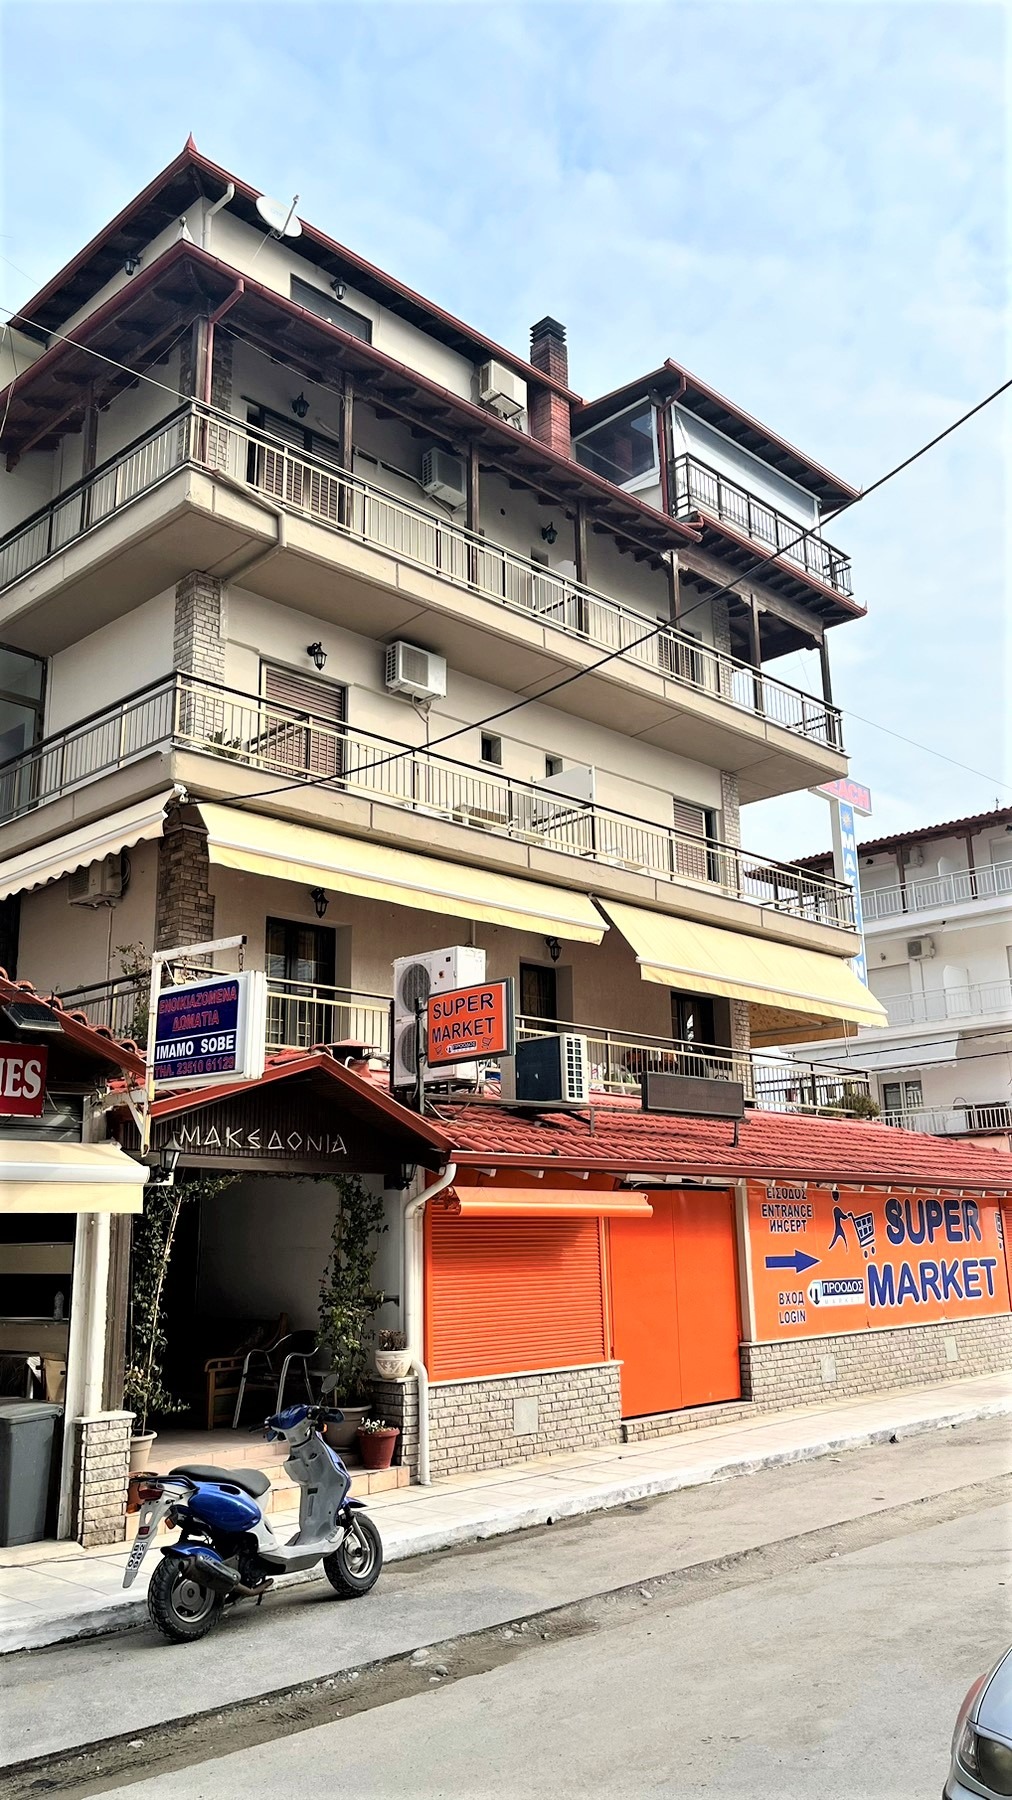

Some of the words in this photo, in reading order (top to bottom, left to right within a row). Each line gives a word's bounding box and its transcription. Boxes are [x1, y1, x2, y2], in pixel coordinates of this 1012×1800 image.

[433, 993, 494, 1019] SUPER
[172, 1009, 219, 1031] ΔΩΜΑΤΙΑ
[432, 1017, 496, 1043] MARKET
[156, 1041, 194, 1060] IMAMO
[201, 1034, 234, 1053] SOBE
[155, 1064, 174, 1077] ΤΗΛ.
[176, 1060, 204, 1075] 23510
[206, 1056, 235, 1071] 61129
[766, 1187, 807, 1200] ΕΙΣΟΔΟΣ
[761, 1204, 812, 1218] ENTRANCE
[884, 1198, 982, 1245] SUPER
[823, 1280, 863, 1294] ΠΡΟΟΔΟΣ
[867, 1258, 998, 1307] MARKET
[778, 1291, 805, 1306] ВХОД
[779, 1310, 806, 1324] LOGIN
